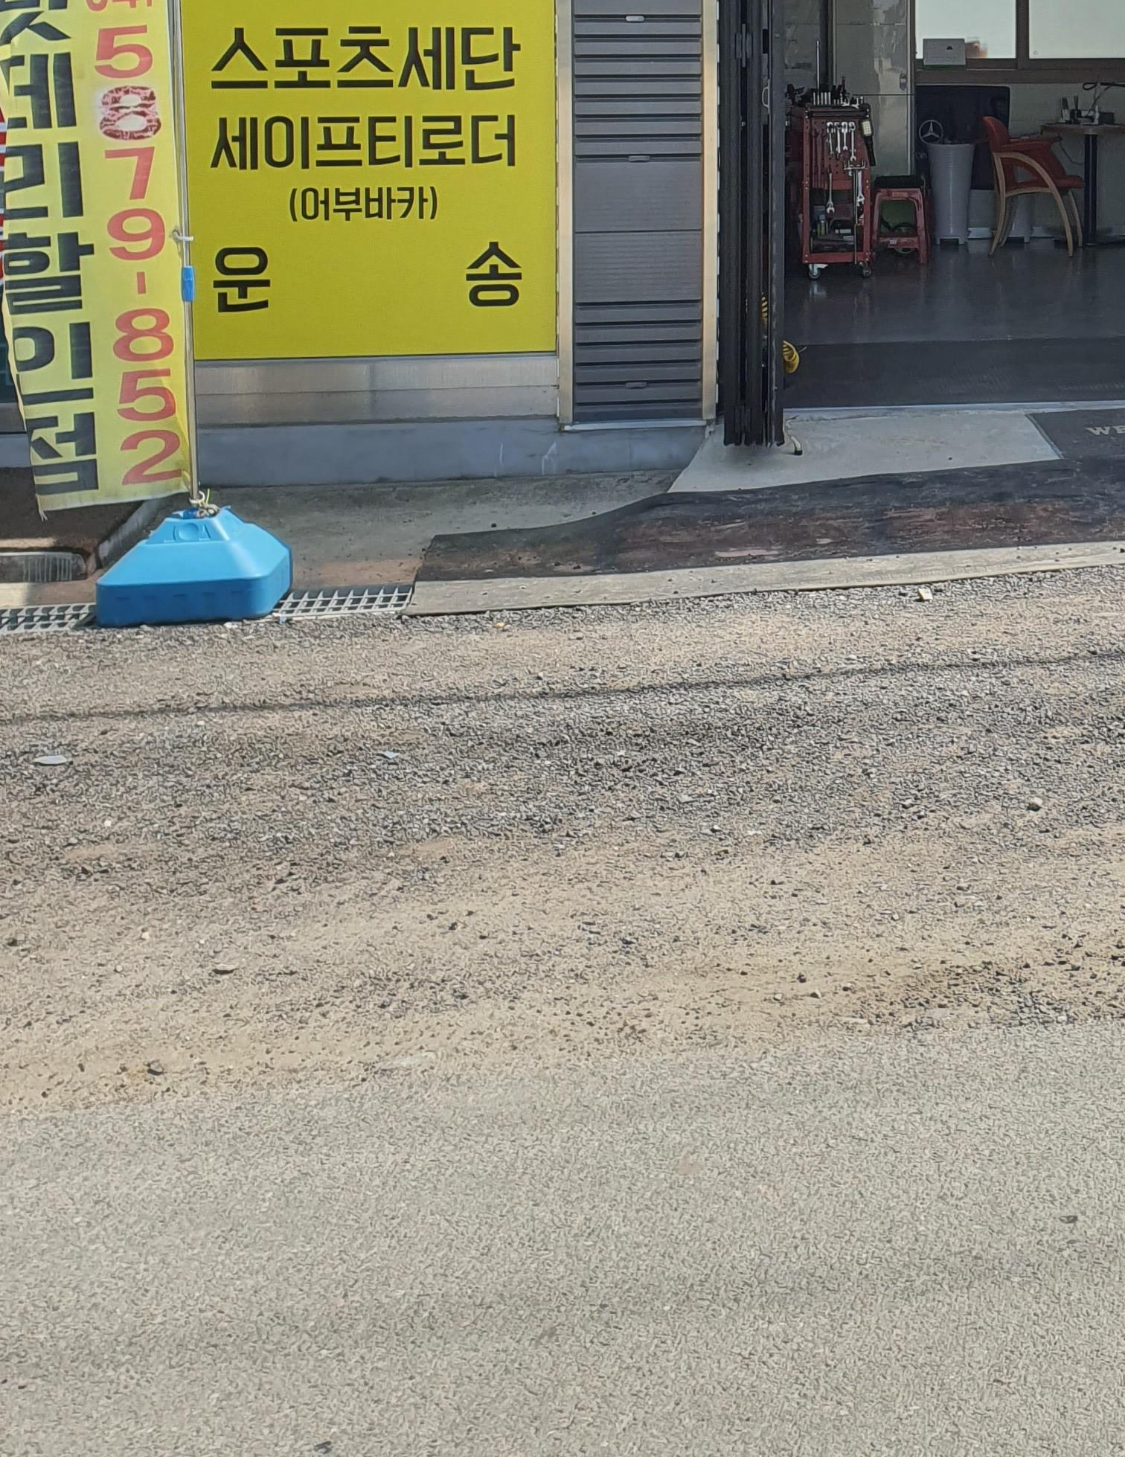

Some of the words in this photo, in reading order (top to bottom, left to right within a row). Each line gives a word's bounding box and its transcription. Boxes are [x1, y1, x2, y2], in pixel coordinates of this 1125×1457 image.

[210, 25, 522, 91] 스포츠세단
[209, 114, 517, 171] 세이프티로더
[288, 185, 439, 223] (어부바카)
